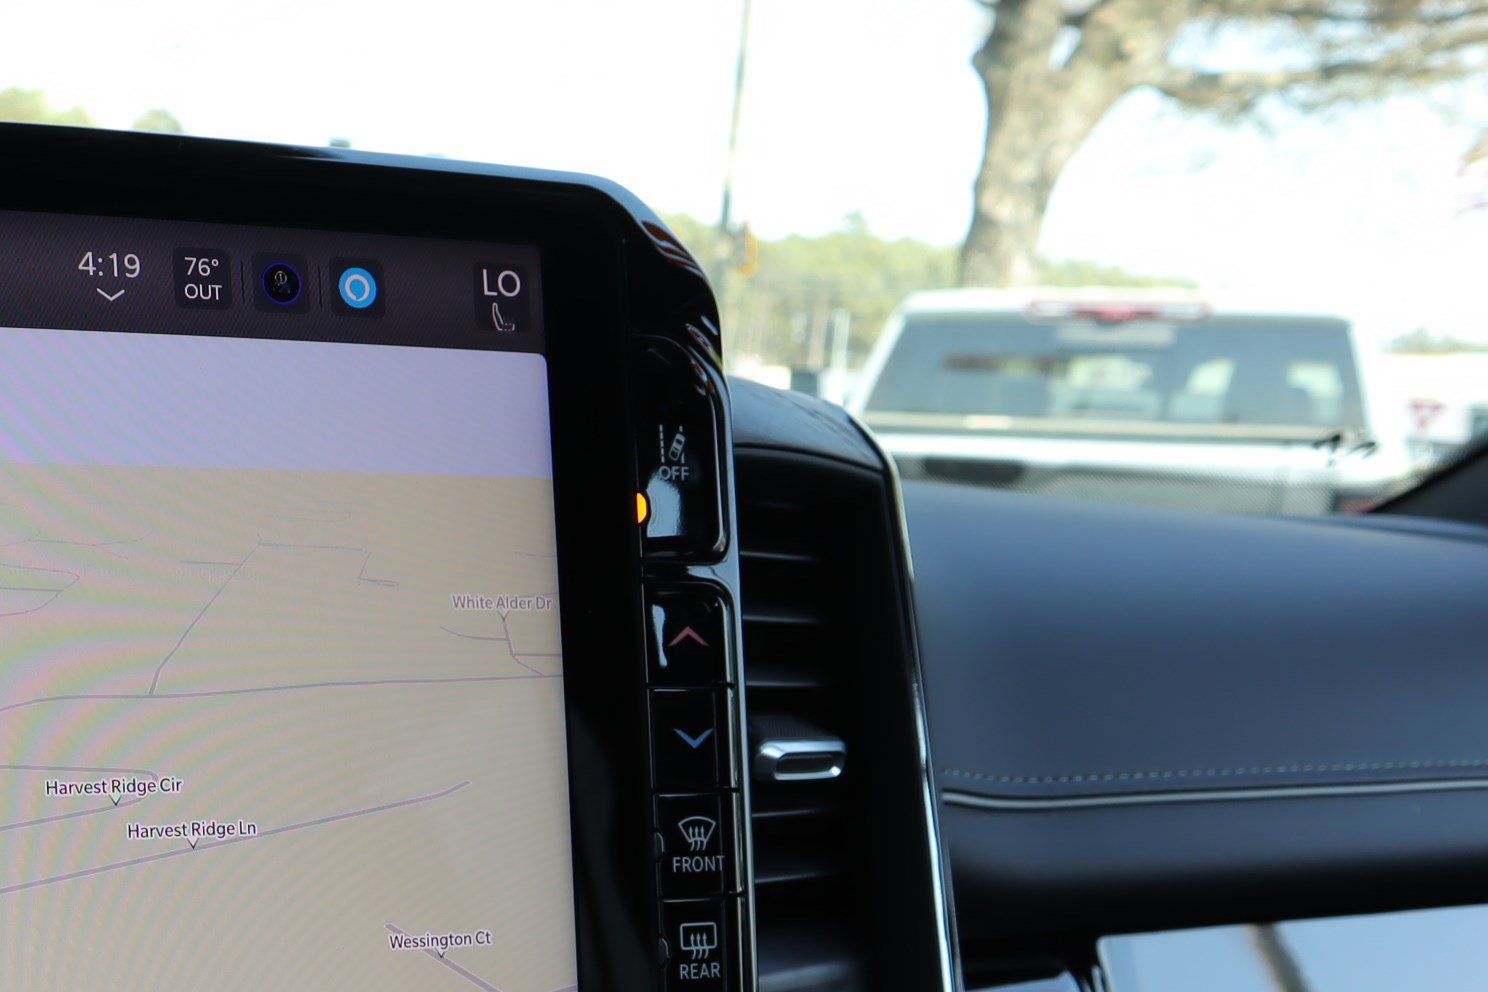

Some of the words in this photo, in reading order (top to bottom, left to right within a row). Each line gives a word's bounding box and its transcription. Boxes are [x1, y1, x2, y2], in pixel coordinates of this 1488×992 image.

[77, 250, 141, 279] 4:19
[183, 255, 220, 278] 76°
[183, 282, 223, 301] OUT
[482, 268, 522, 298] LO
[657, 464, 691, 483] OFF
[452, 595, 492, 610] White
[496, 595, 532, 611] Alder
[535, 596, 553, 611] Dr
[45, 777, 107, 796] Harvest
[111, 777, 156, 798] Ridge
[158, 777, 183, 794] Cir
[127, 821, 189, 840] Harvest
[192, 820, 236, 839] Ridge
[238, 821, 257, 836] Ln
[672, 855, 726, 873] FRONT
[388, 932, 473, 951] Wessington
[475, 931, 492, 946] Ct
[679, 962, 721, 980] REAR
